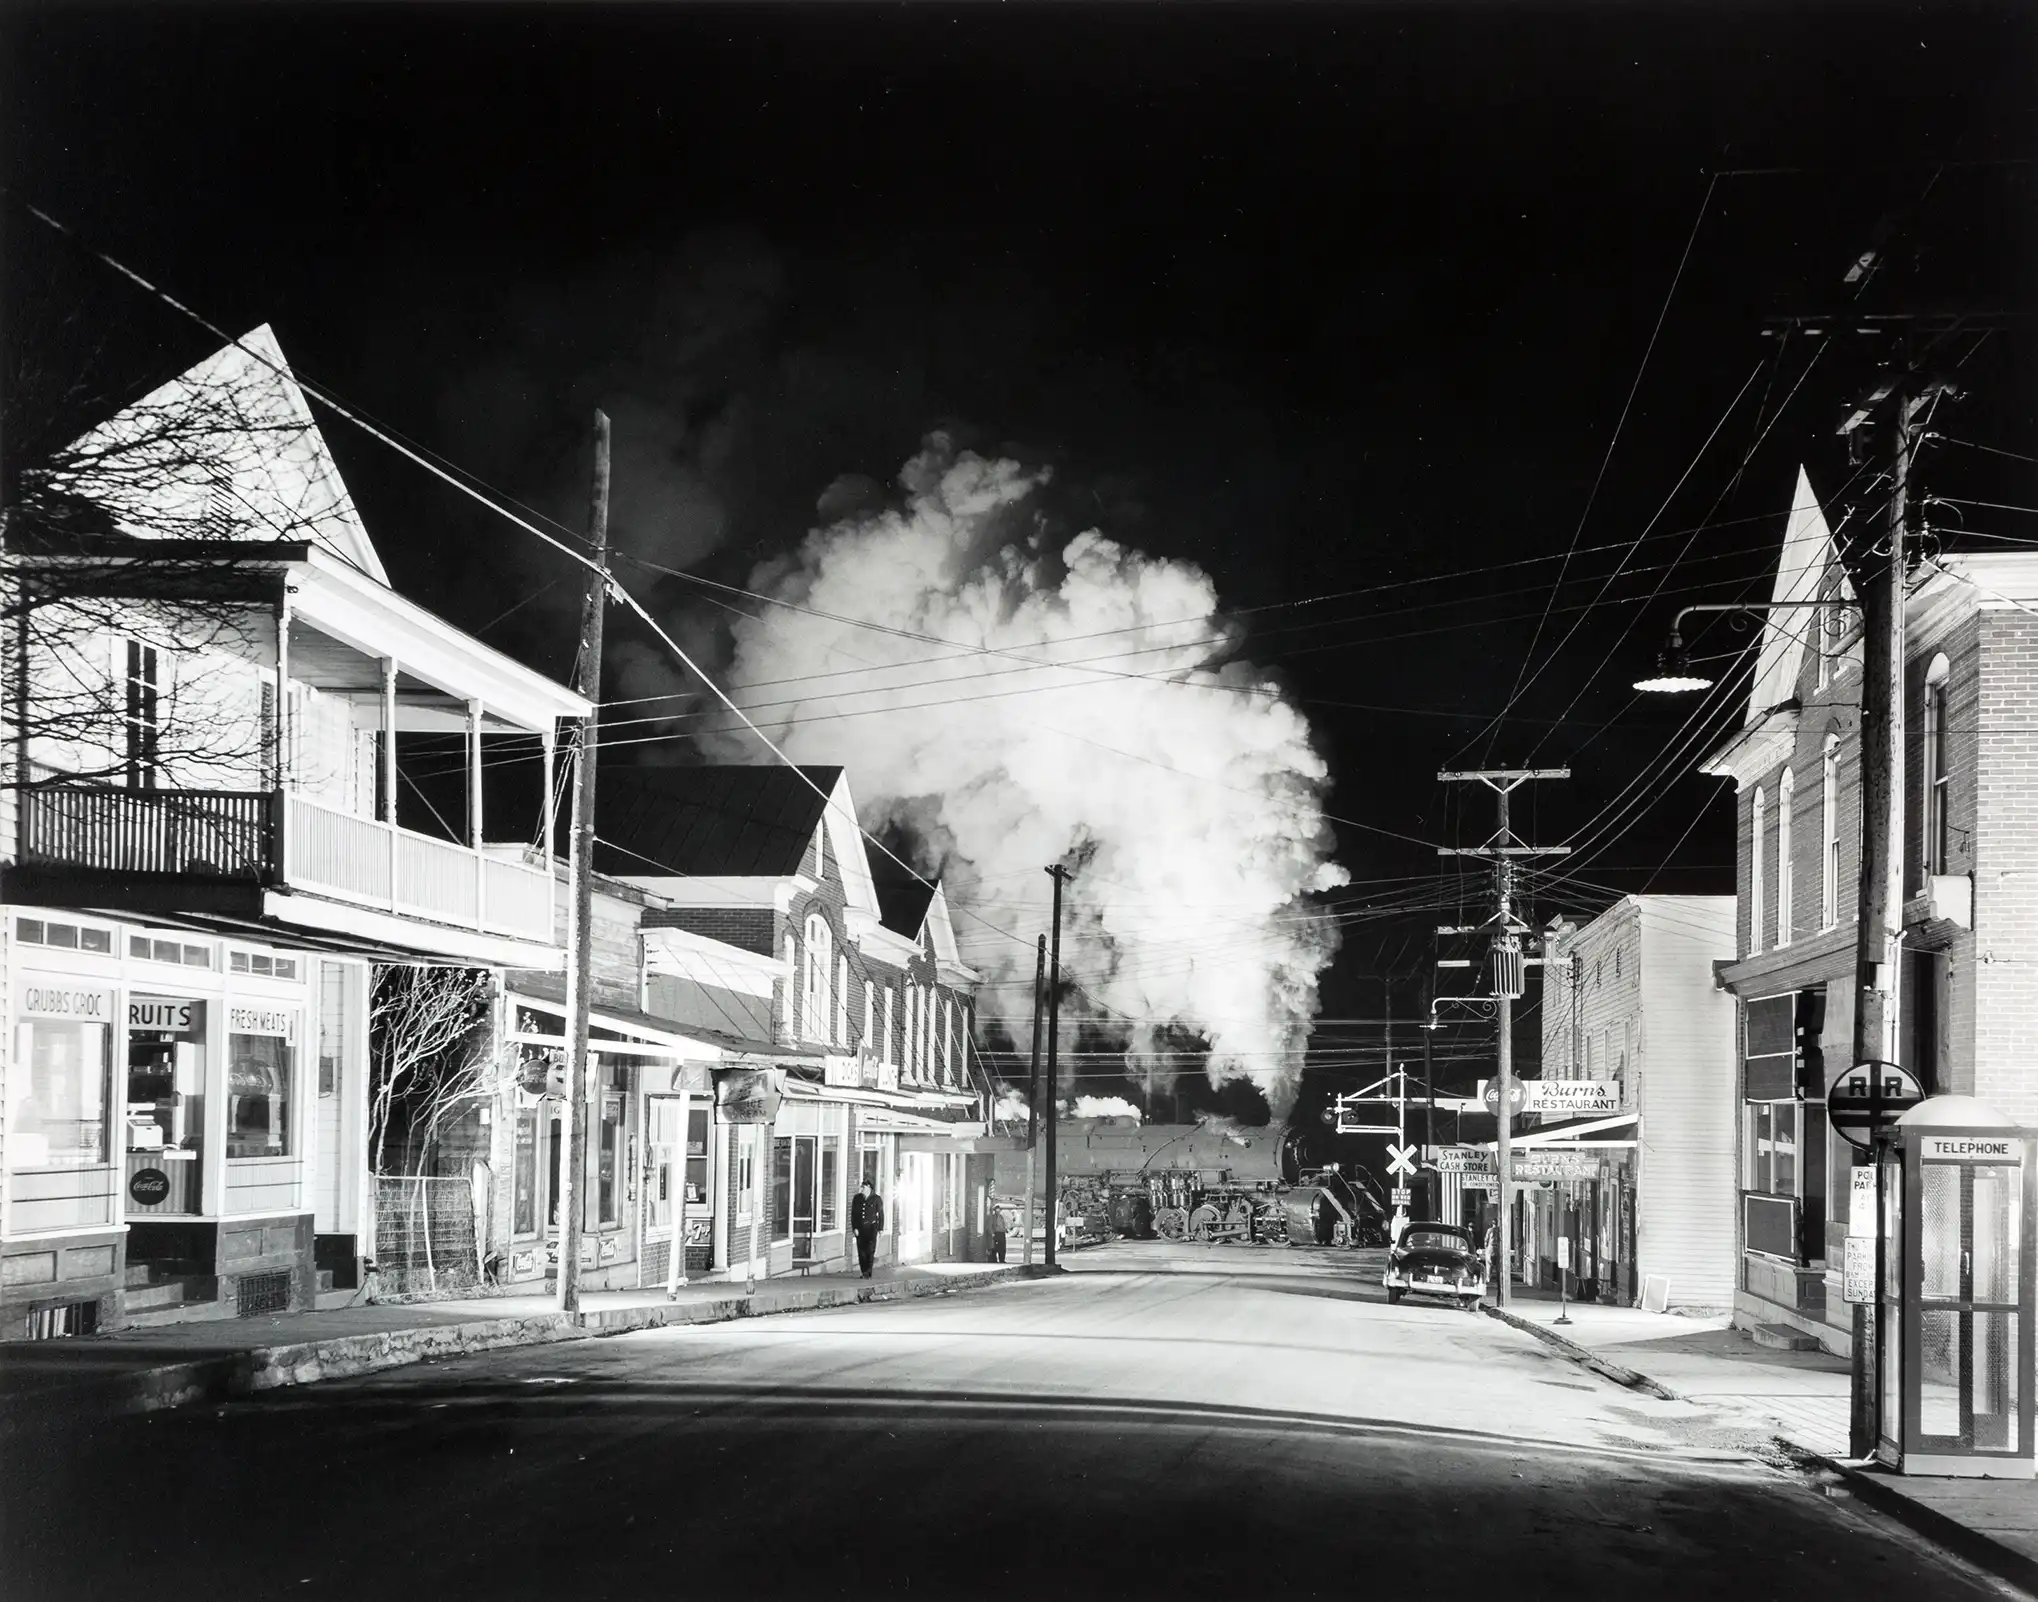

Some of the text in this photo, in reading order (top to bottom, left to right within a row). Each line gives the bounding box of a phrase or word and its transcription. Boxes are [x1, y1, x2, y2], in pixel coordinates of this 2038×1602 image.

[26, 988, 70, 1013] GRUBBS
[129, 1004, 192, 1026] RUITS
[231, 1008, 286, 1032] FRESH MEATS
[746, 1099, 763, 1109] ICE
[1533, 1099, 1617, 1110] RESTAURANT
[1934, 1141, 2009, 1155] TELEPHONE
[1442, 1149, 1489, 1162] STANLEY
[1440, 1161, 1489, 1172] CASH STORE
[133, 1180, 164, 1191] Coca-Cola
[1847, 1278, 1874, 1289] EXCEP
[1847, 1288, 1874, 1298] SUNDA
